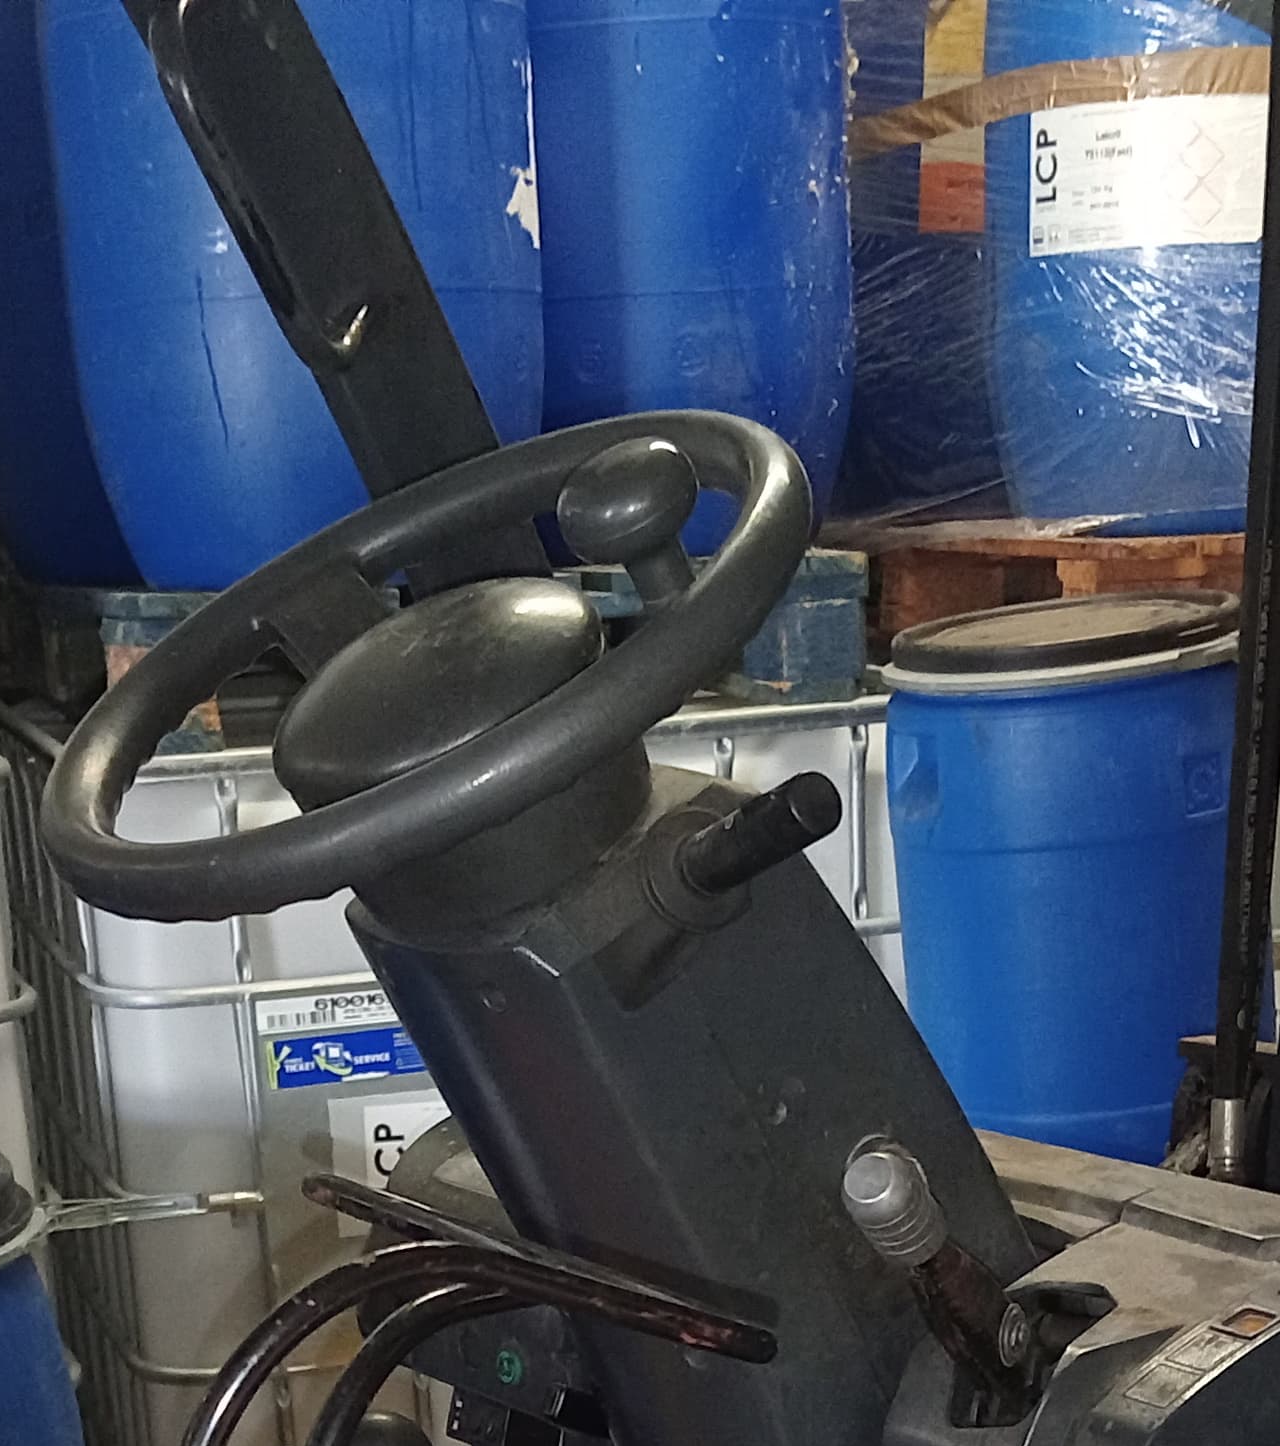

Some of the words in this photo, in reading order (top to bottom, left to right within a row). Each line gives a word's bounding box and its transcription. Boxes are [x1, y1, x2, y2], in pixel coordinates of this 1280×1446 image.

[1035, 128, 1058, 205] LCP
[353, 1052, 391, 1066] SERVICE
[374, 1124, 405, 1176] CP
